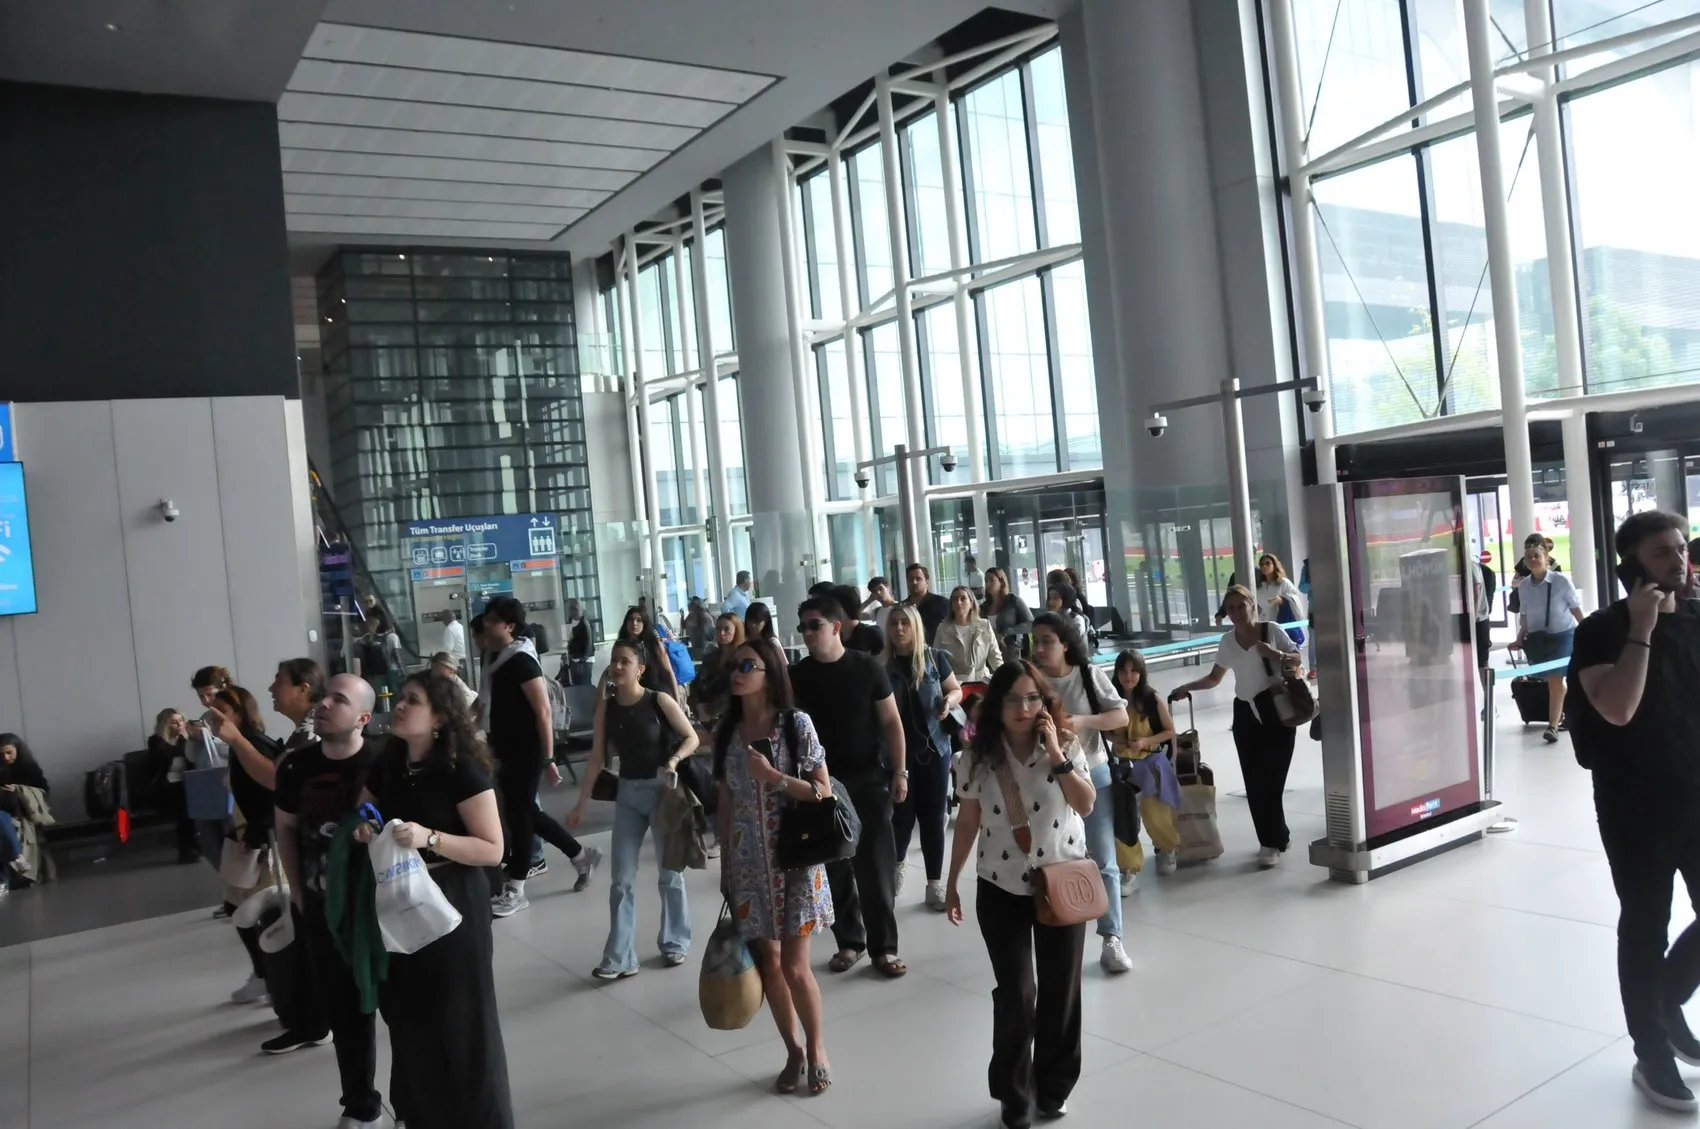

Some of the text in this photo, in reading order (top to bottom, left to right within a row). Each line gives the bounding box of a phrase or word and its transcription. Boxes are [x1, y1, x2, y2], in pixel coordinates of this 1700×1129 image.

[409, 522, 498, 535] Tüm Transfer Uçuşları
